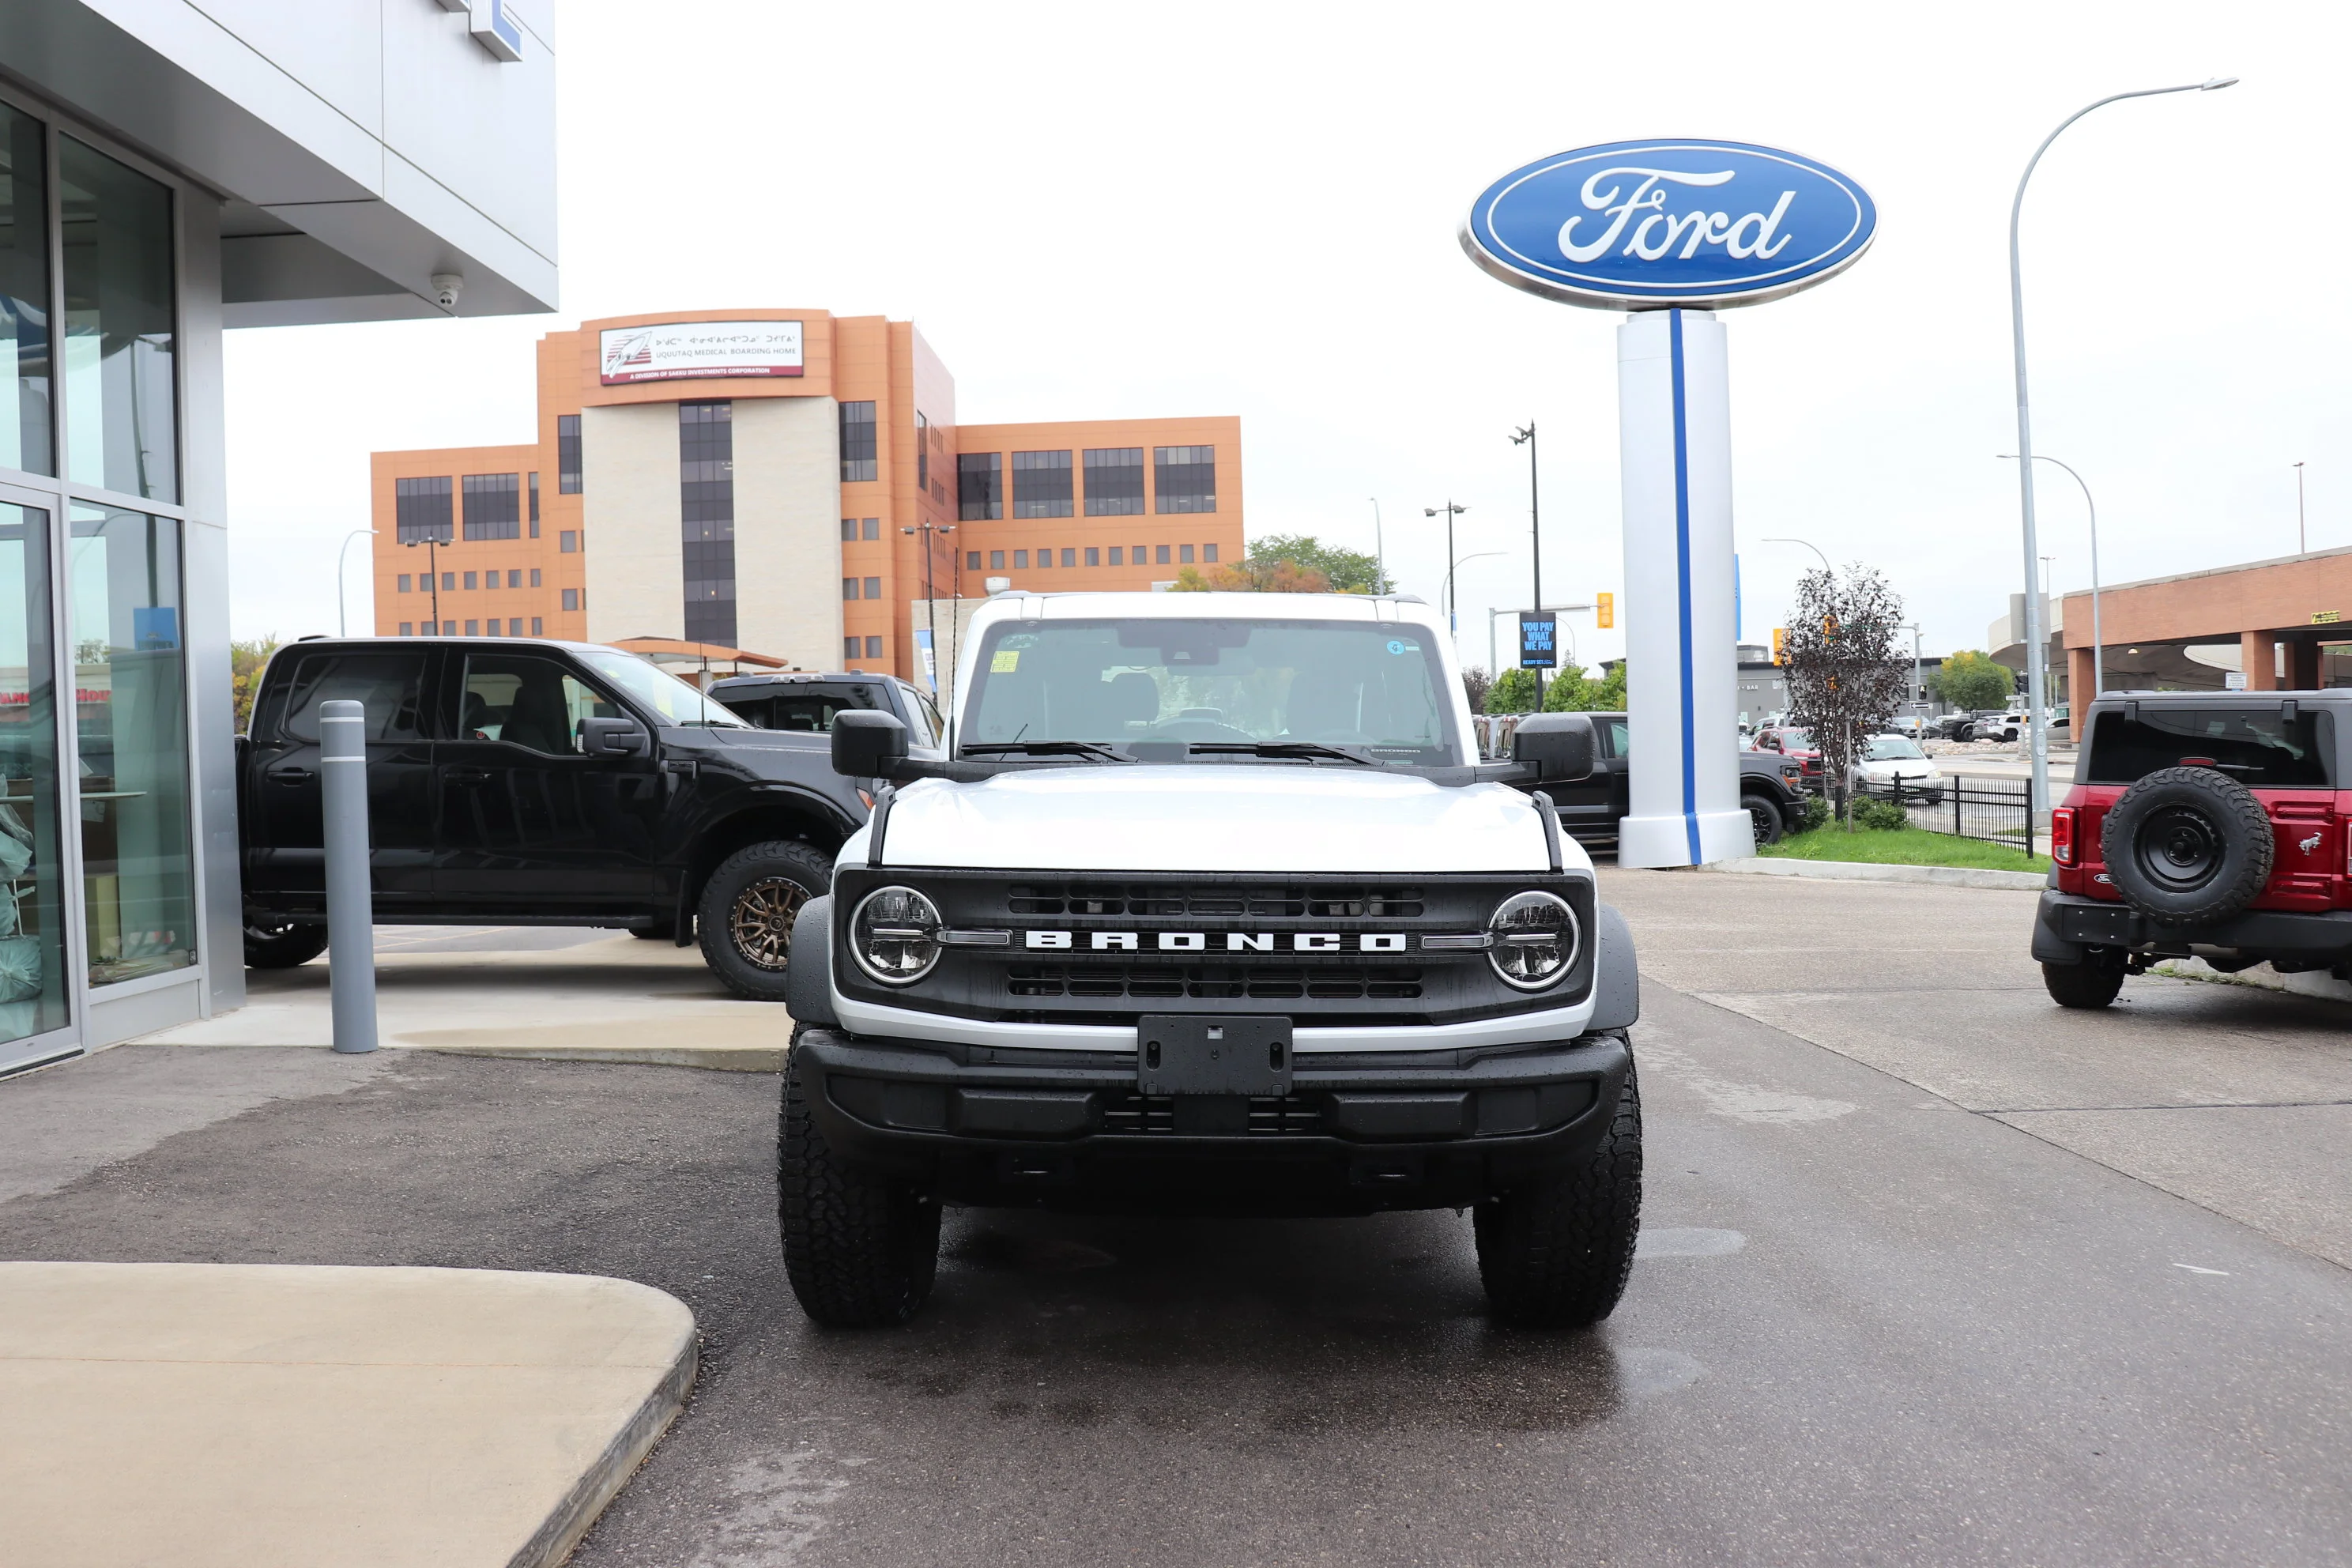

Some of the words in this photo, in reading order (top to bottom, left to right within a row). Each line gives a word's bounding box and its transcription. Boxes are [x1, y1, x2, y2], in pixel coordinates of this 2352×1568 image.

[1558, 167, 1796, 263] Ford
[656, 349, 693, 359] UQUUTAQ
[1522, 622, 1539, 631] YOU
[1540, 622, 1554, 631] PAY
[1527, 631, 1549, 640] WHAT
[1524, 641, 1537, 650] WE
[1538, 641, 1553, 650] PAY
[1026, 930, 1407, 952] BRONCO
